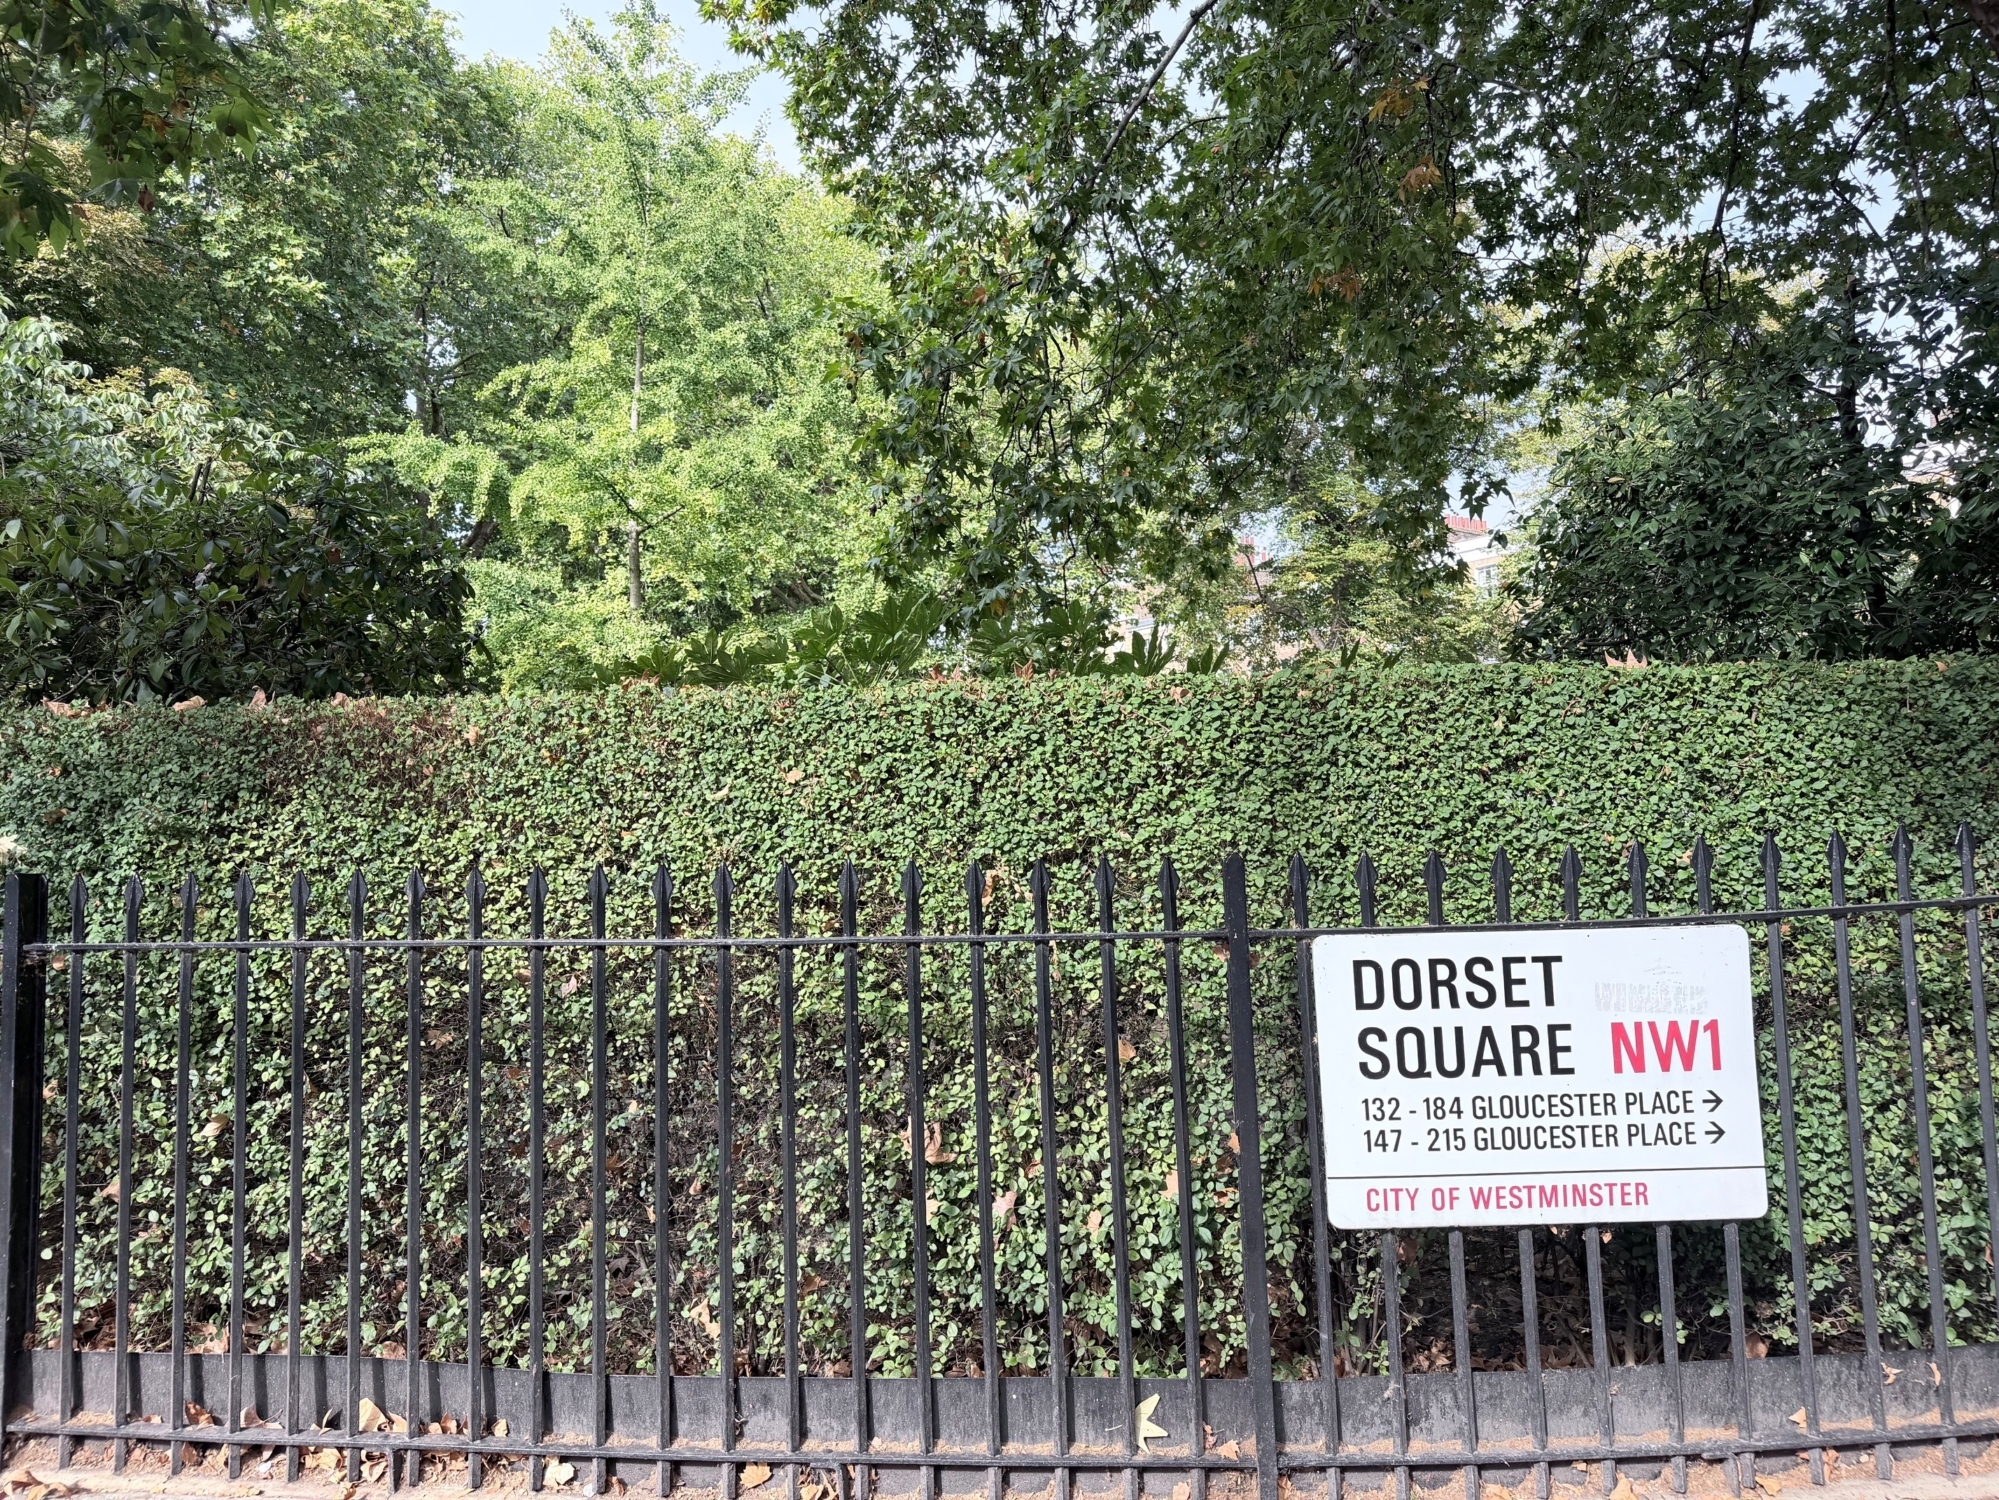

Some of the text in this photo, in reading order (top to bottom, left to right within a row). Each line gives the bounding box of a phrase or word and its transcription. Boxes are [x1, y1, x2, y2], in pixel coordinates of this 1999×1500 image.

[1353, 956, 1562, 1010] DORSET
[1358, 1019, 1721, 1080] SQUARE NW1
[1362, 1097, 1401, 1121] 132
[1423, 1097, 1463, 1120] 184
[1472, 1093, 1617, 1119] GLOUCESTER
[1625, 1090, 1694, 1115] PLACE
[1364, 1129, 1401, 1152] 147
[1427, 1128, 1466, 1151] 215
[1474, 1124, 1618, 1151] GLOUCESTER
[1627, 1122, 1696, 1146] PLACE
[1367, 1183, 1648, 1212] CITY OF WESTMINSTER
